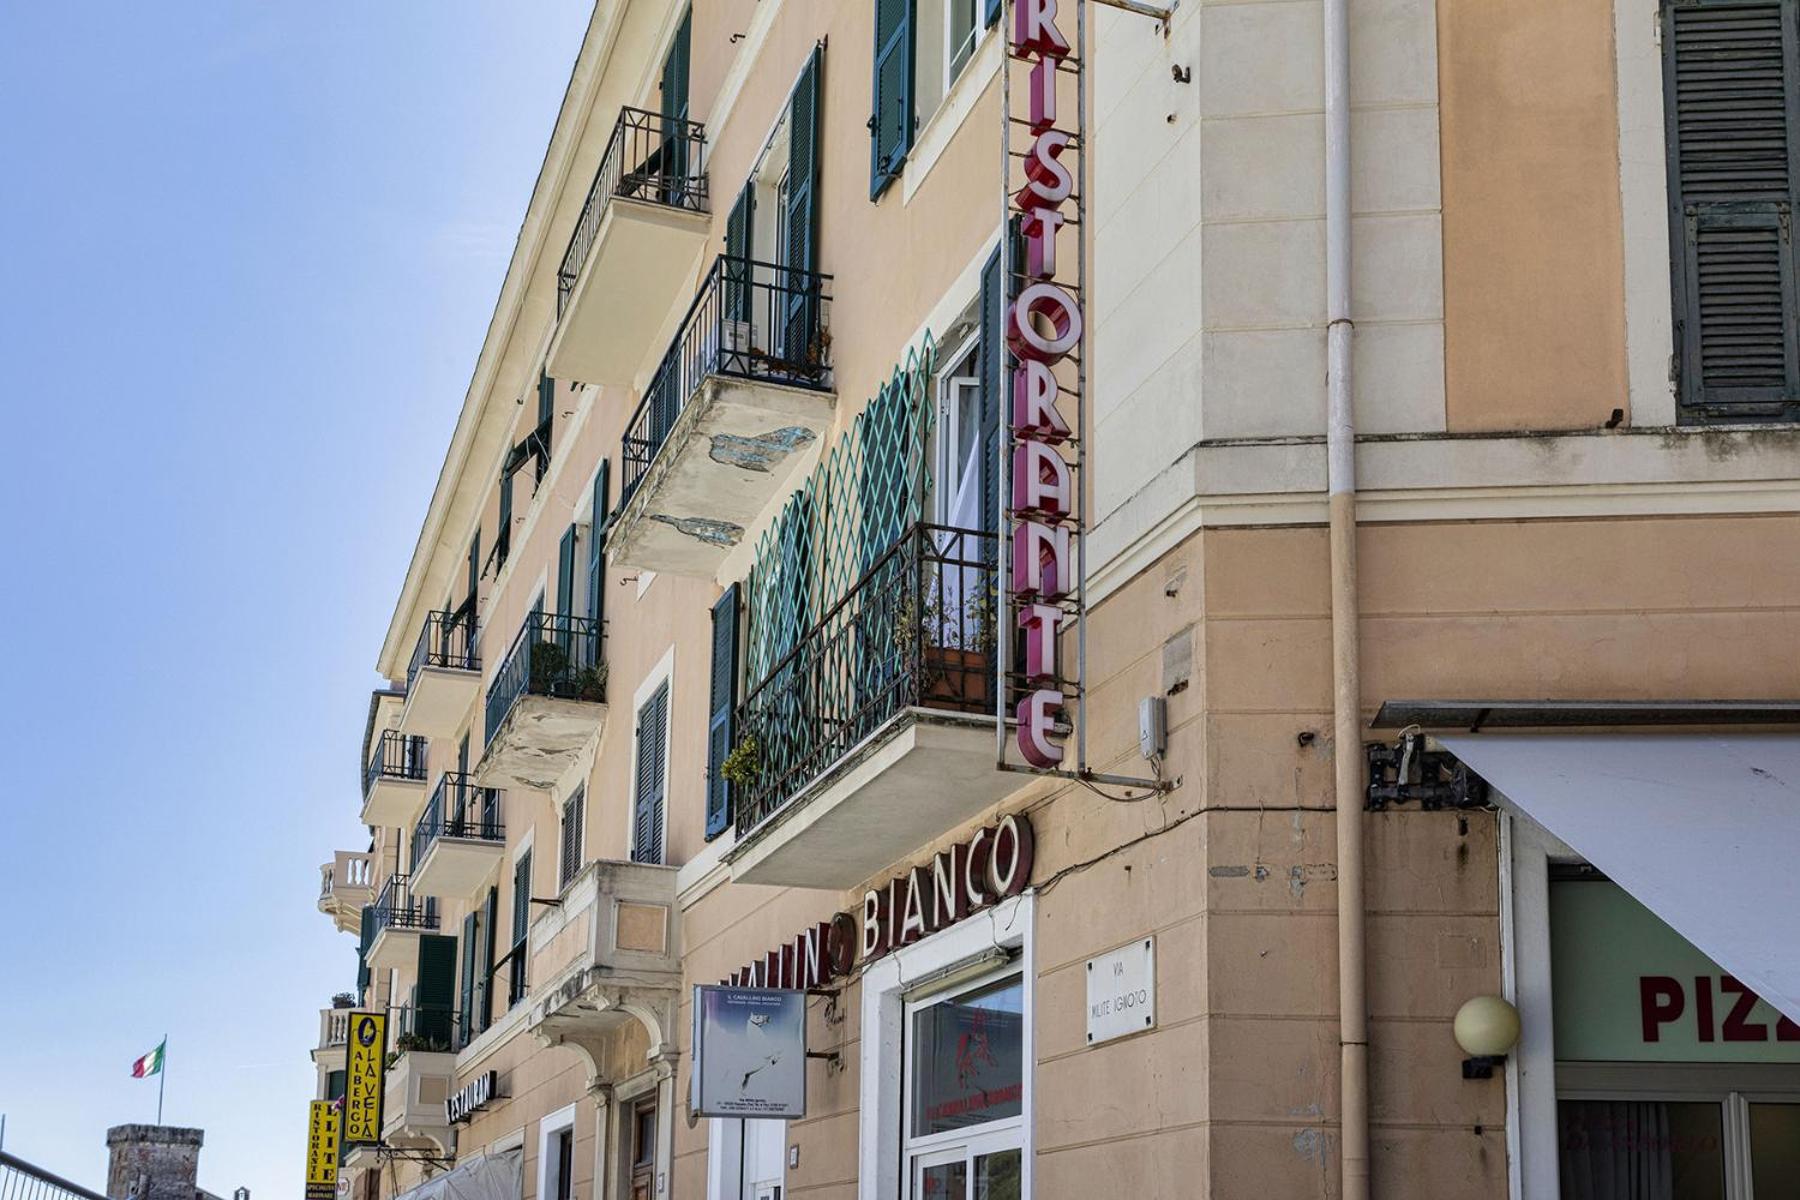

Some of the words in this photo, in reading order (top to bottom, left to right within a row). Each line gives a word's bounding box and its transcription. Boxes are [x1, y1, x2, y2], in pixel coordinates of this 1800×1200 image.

[1006, 0, 1082, 768] RISTORANTE
[863, 813, 1034, 960] BIANCO
[1113, 961, 1124, 977] VIA
[349, 1050, 364, 1135] ALBERGO
[364, 1048, 377, 1077] LA
[361, 1083, 377, 1138] VELA
